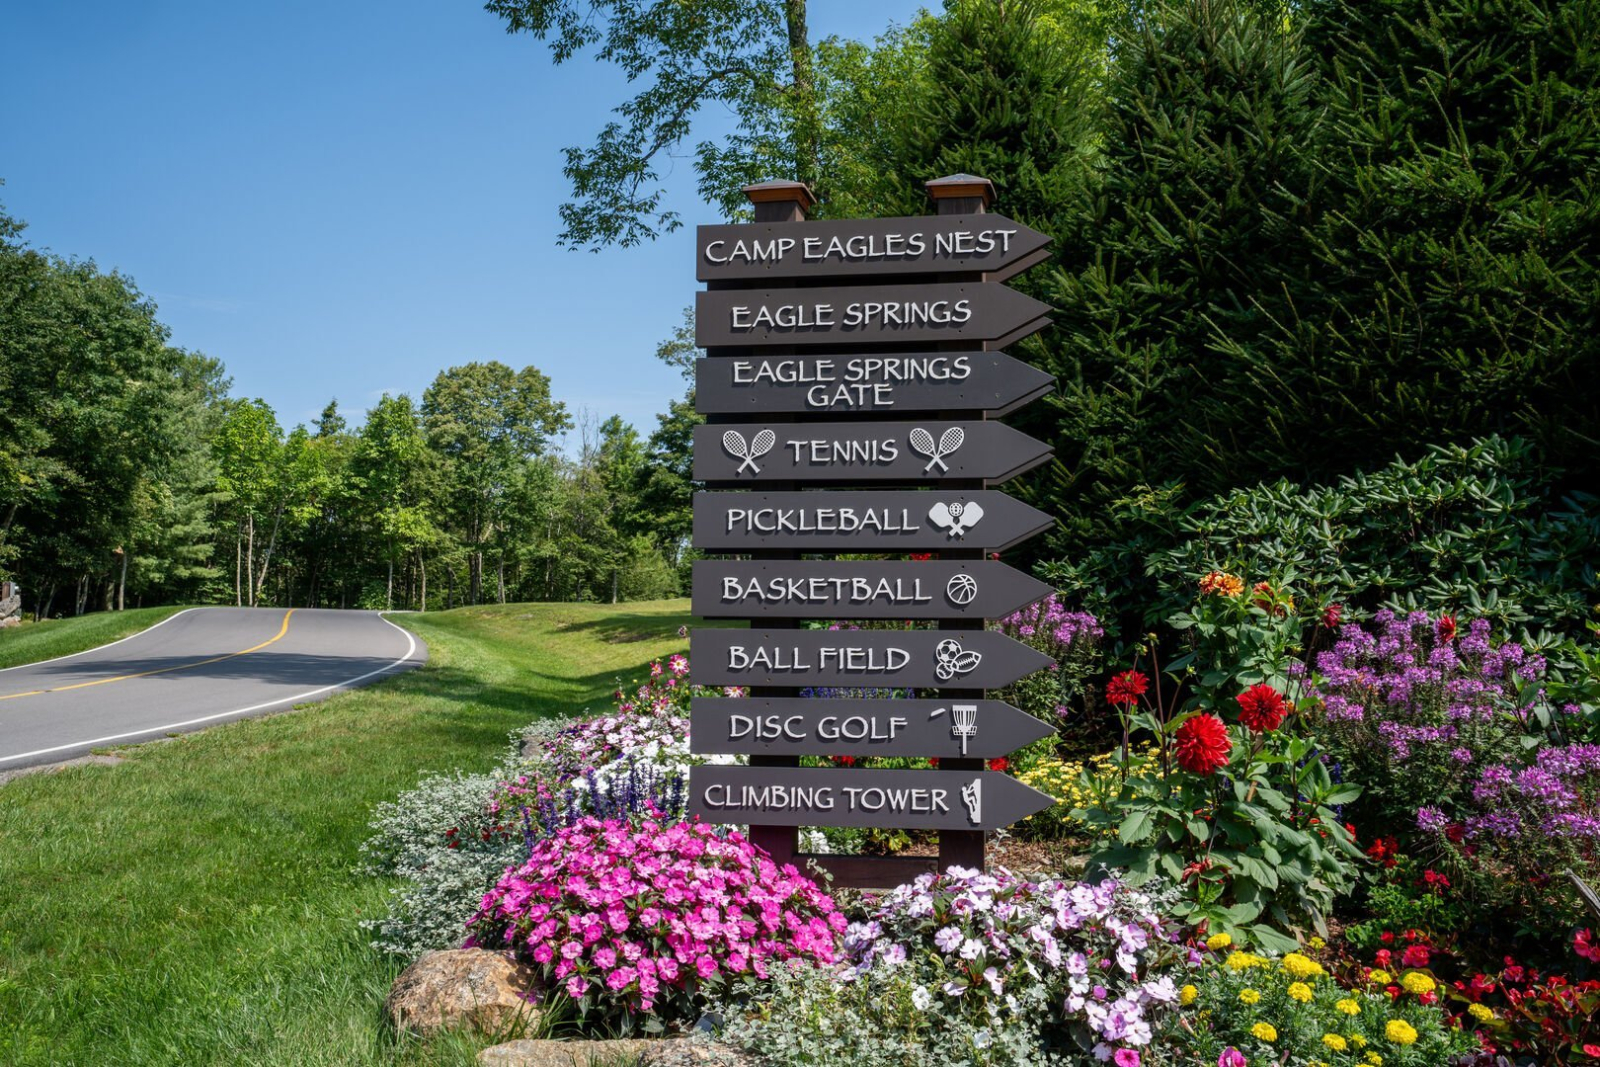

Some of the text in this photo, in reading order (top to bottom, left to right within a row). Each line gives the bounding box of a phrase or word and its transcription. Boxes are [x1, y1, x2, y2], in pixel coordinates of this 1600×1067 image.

[705, 229, 1018, 263] CAMP EAGLES NEST
[732, 299, 972, 328] EAGLE SPRINGS
[733, 356, 972, 383] EAGLE SPRINGS
[807, 383, 895, 407] GATE
[786, 438, 899, 462] TENNIS
[727, 507, 921, 531] PICKLEBALL
[722, 576, 933, 601] BASKETBALL
[728, 645, 911, 670] BALL FIELD
[729, 714, 908, 739] DISC GOLF
[704, 783, 950, 812] CLIMBING TOWER
